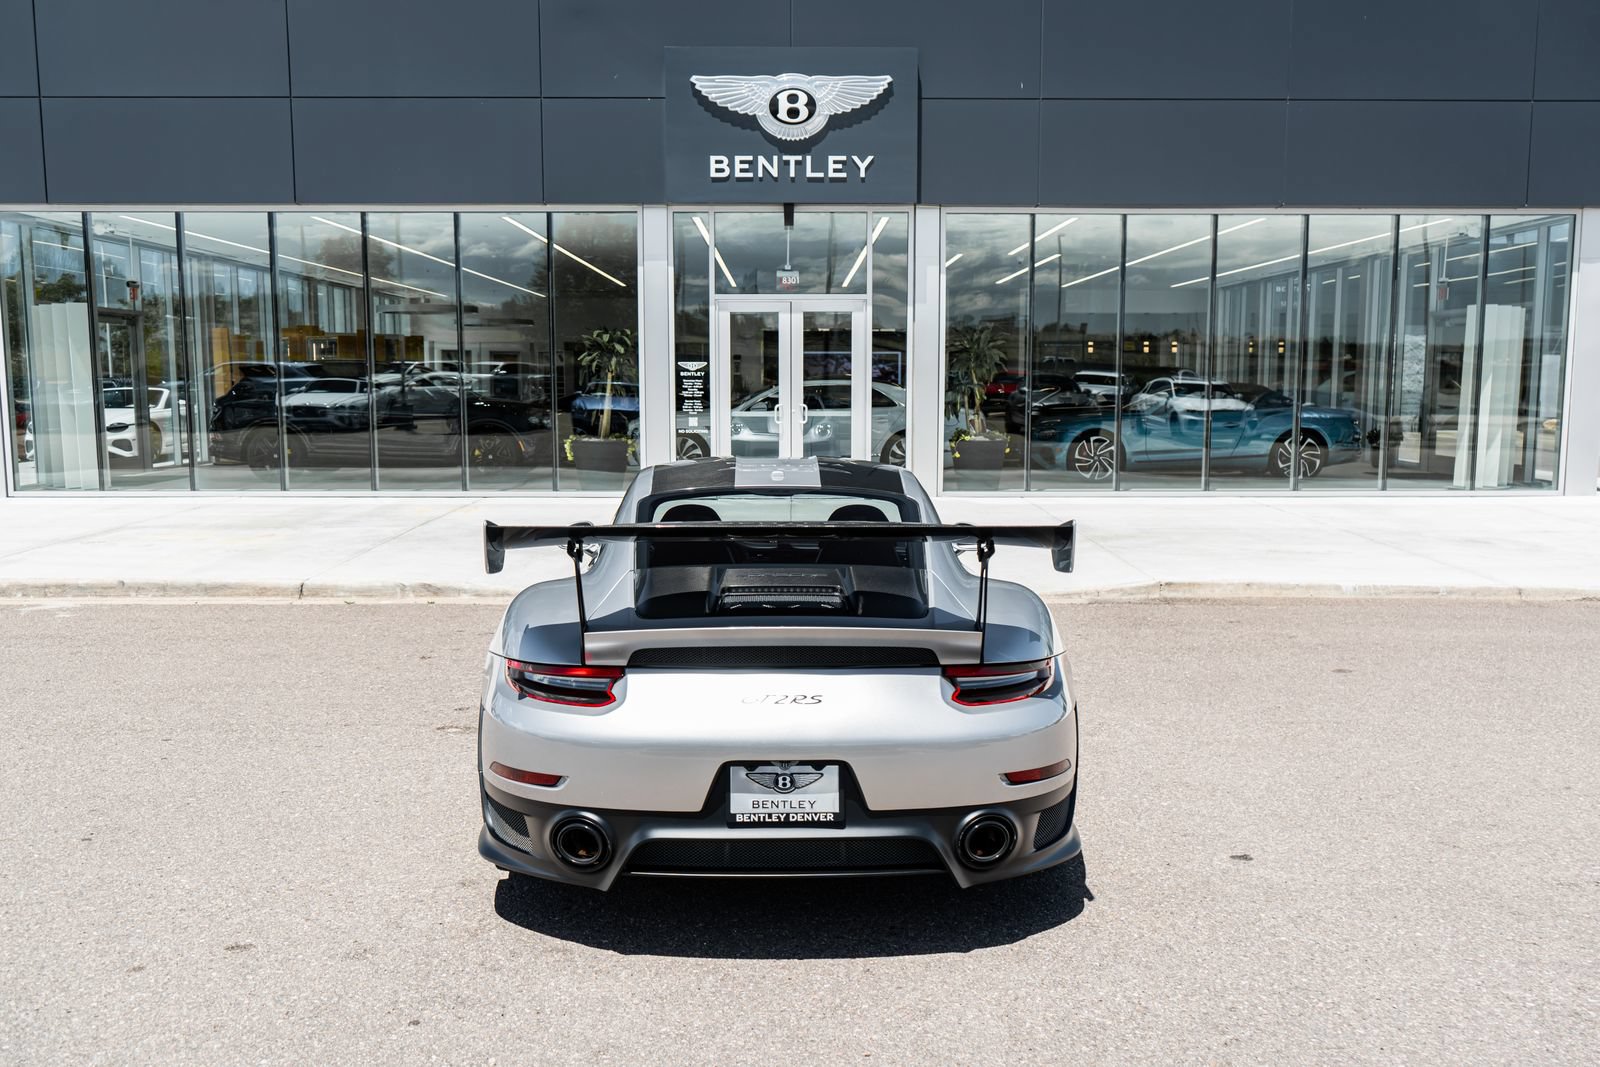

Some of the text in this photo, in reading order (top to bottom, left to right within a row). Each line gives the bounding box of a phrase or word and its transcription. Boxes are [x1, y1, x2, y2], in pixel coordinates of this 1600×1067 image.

[776, 89, 809, 123] B
[709, 155, 875, 178] BENTLEY
[782, 276, 800, 284] 8301
[751, 800, 817, 809] BENTLEY
[735, 813, 834, 822] BENTLEY DENVER
